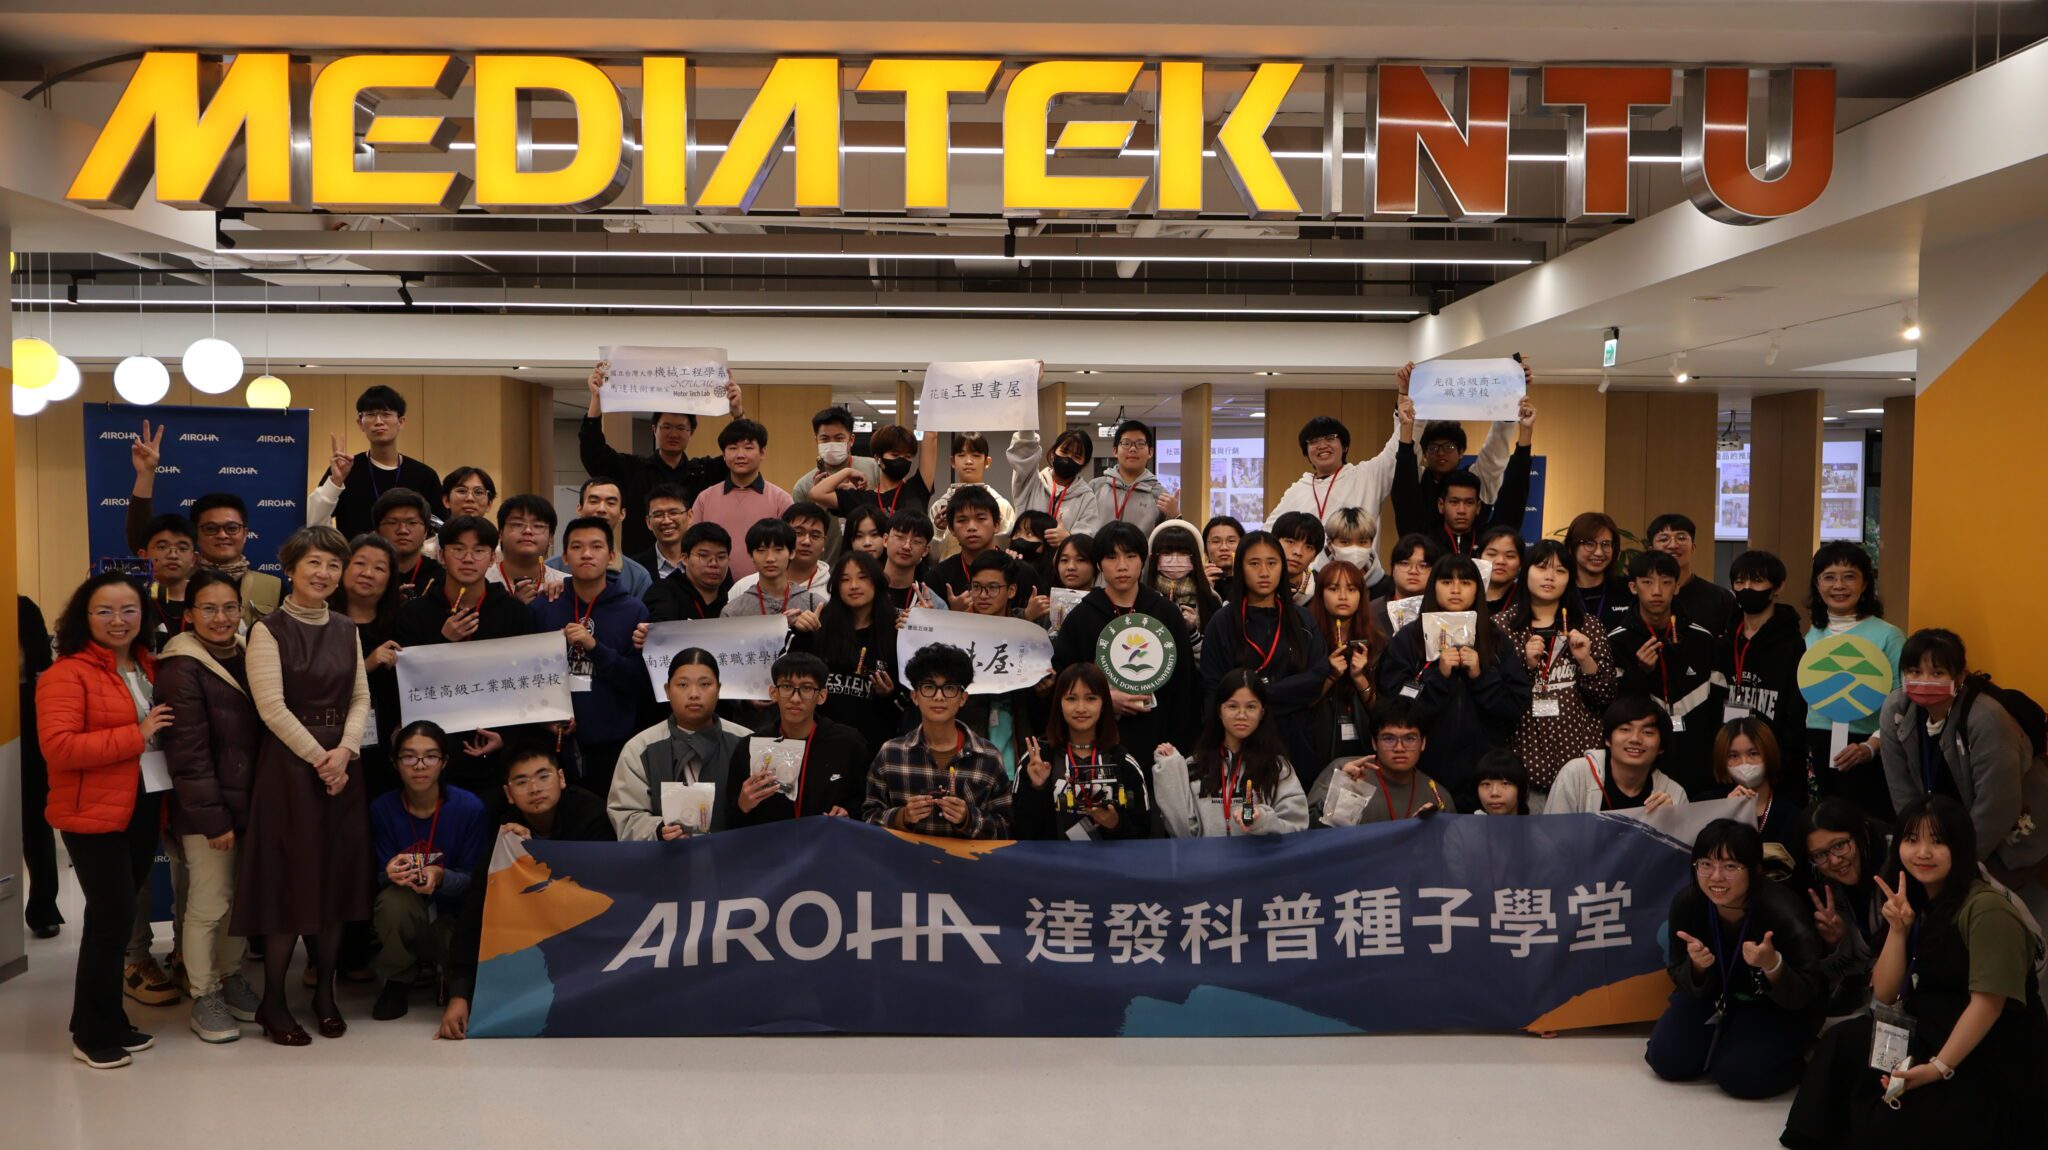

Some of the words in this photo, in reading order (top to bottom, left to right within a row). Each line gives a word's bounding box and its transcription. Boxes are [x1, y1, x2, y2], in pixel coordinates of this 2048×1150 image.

[66, 51, 1303, 214] MEDIATEK
[1373, 64, 1837, 222] NTU
[1445, 388, 1490, 397] 職業學校
[179, 433, 219, 441] AIROHA
[256, 434, 296, 443] AIROHA
[218, 467, 258, 475] AIROHA
[257, 499, 296, 507] AIROHA
[257, 563, 281, 571] AIRO
[1100, 655, 1119, 684] NATIONAL
[1120, 681, 1140, 691] DONG
[1141, 683, 1156, 691] HWA
[1156, 654, 1175, 686] UNIVERSITY
[408, 673, 562, 702] 花蓮高級工業職業學校
[601, 890, 1002, 973] AIROHA
[1024, 880, 1633, 966] 達發科普種子學堂
